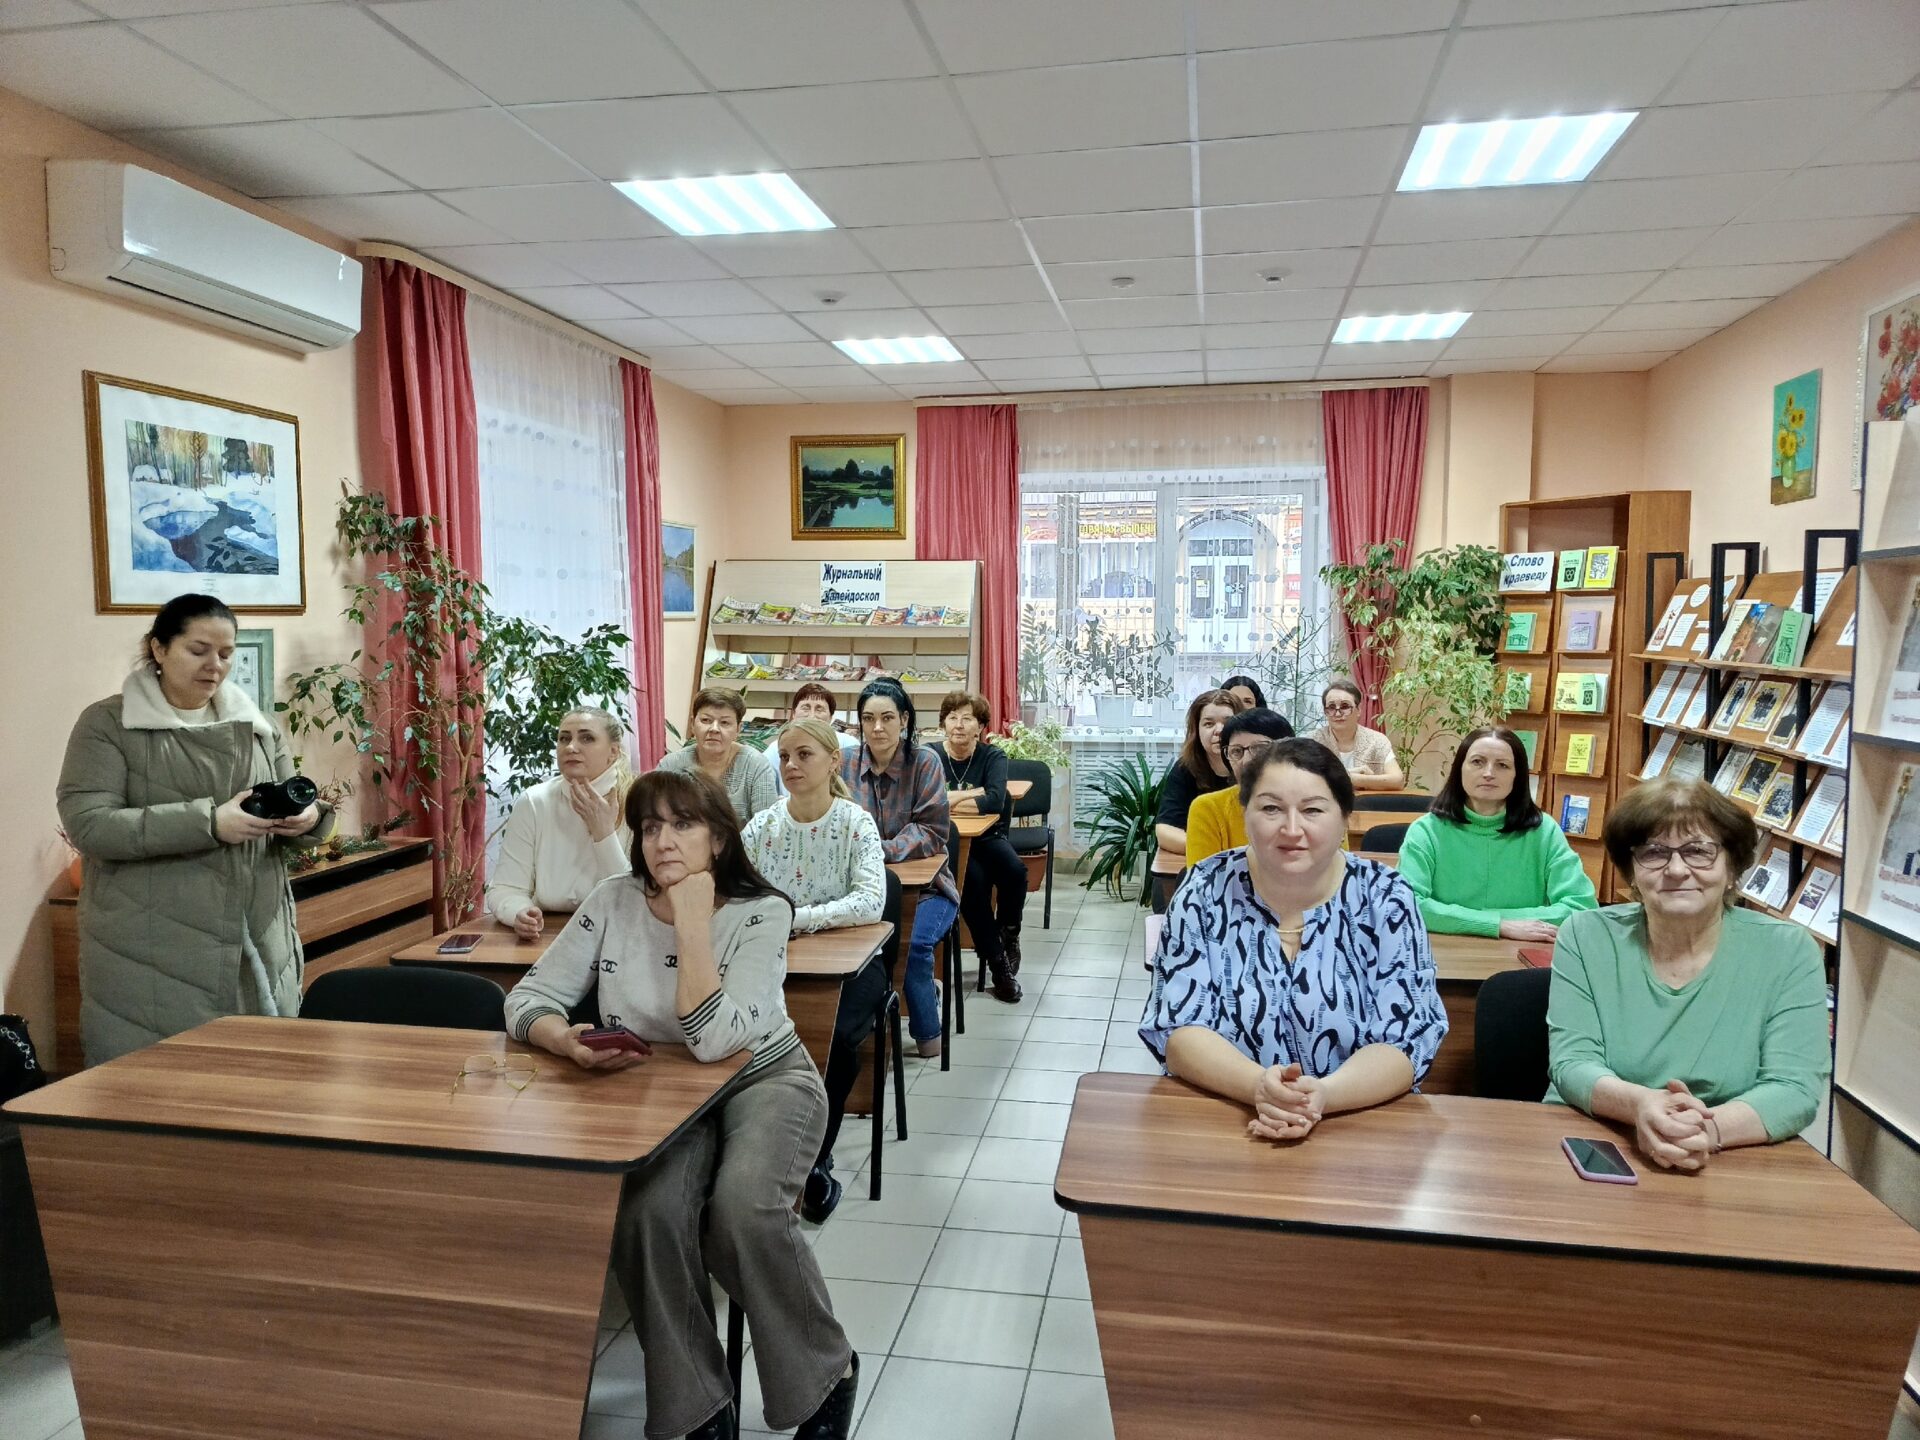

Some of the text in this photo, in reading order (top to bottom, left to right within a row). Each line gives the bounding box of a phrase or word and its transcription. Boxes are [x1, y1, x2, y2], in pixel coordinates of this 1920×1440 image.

[1510, 554, 1544, 567] Слово
[822, 562, 882, 584] Журнальный
[1503, 571, 1547, 588] краеведу
